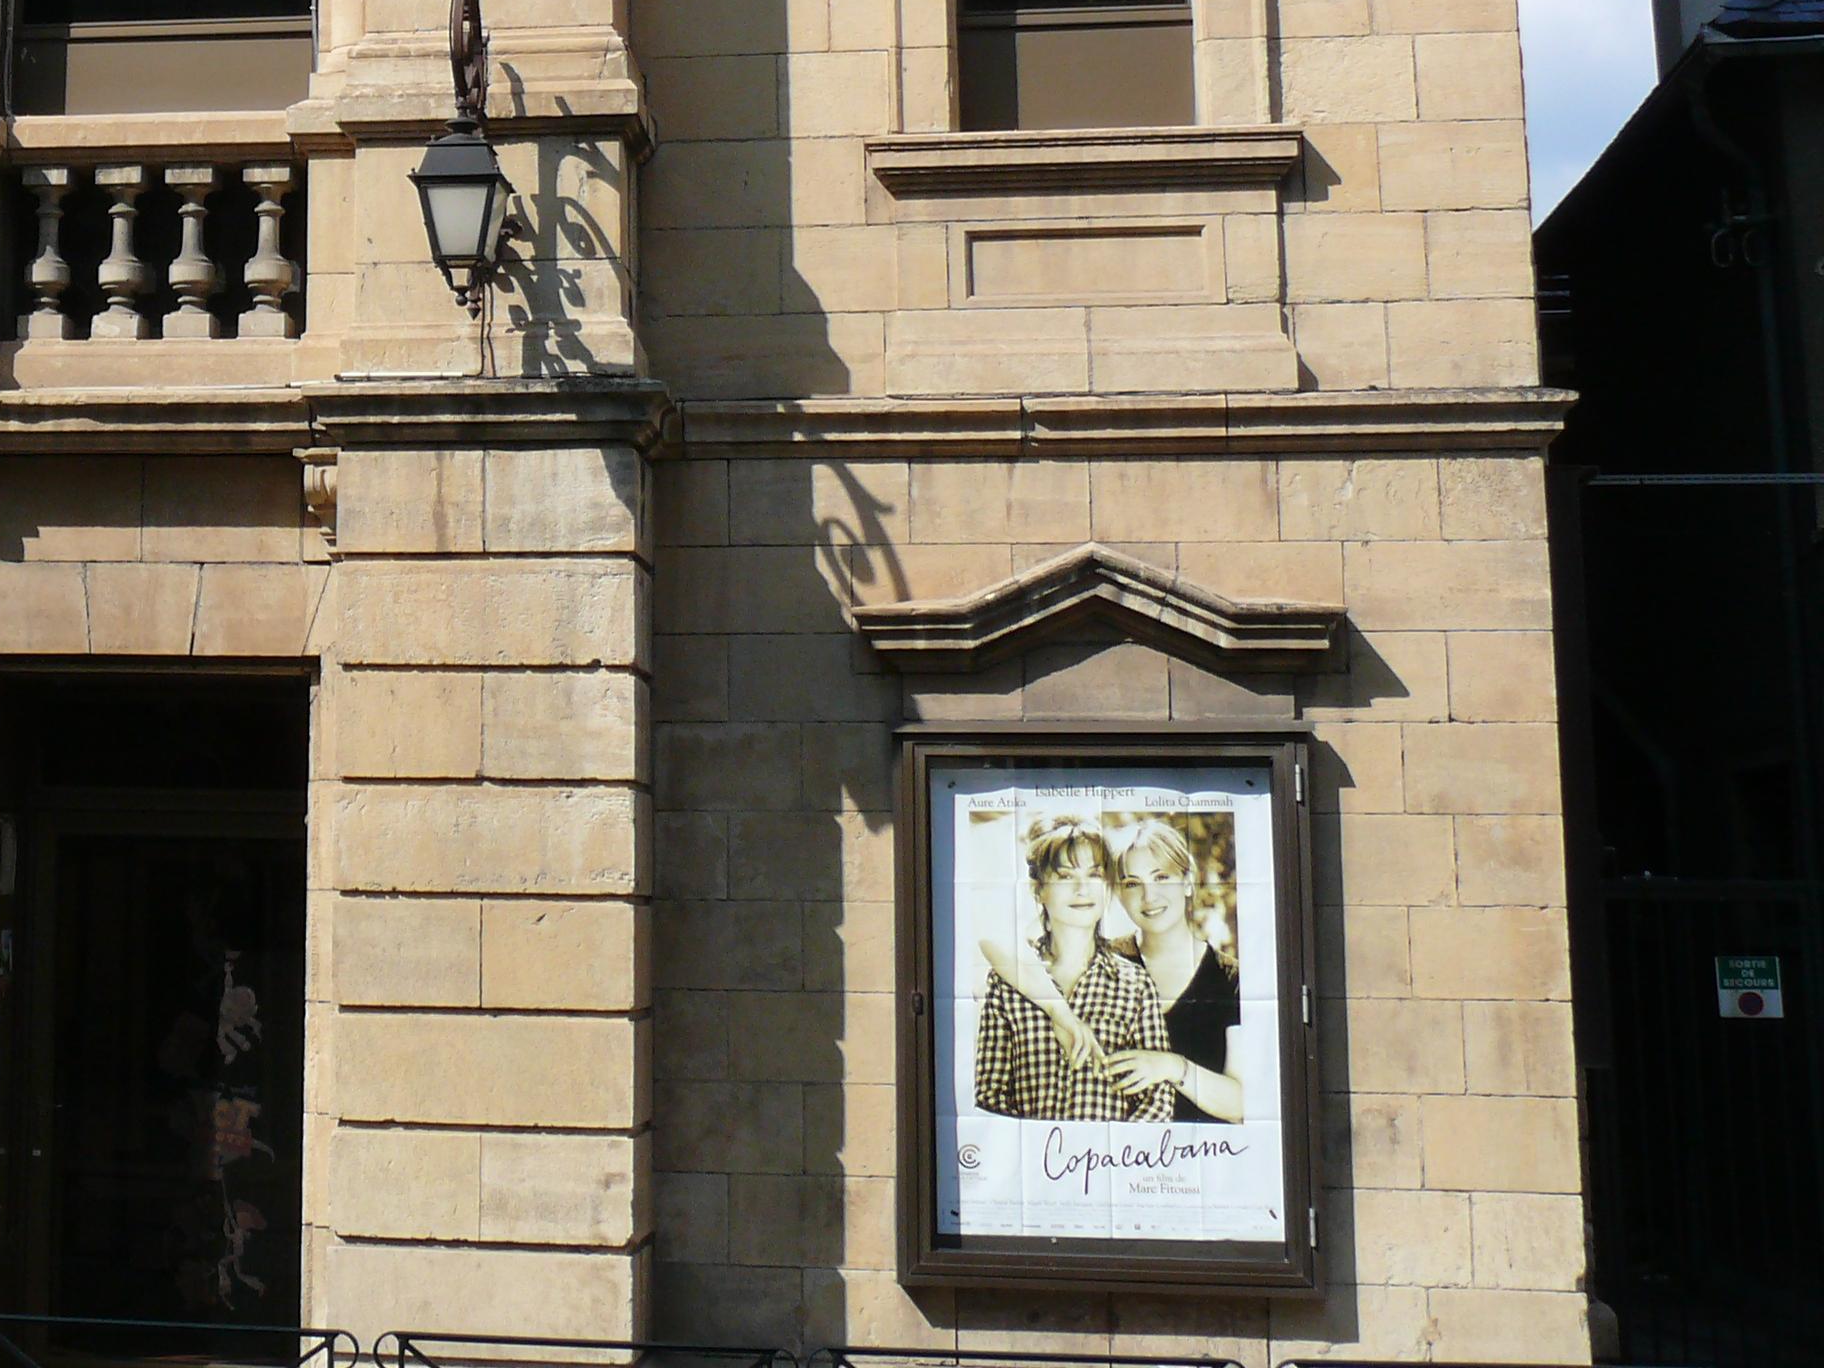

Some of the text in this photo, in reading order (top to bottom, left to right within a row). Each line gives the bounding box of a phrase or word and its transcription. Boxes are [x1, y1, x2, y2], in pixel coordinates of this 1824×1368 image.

[1035, 785, 1136, 801] Isabelle Huppert
[968, 796, 1026, 807] Aure Atika
[1145, 795, 1233, 807] Lolita Chammah
[1728, 959, 1766, 968] SORTIE
[1741, 969, 1755, 978] DE
[1723, 978, 1776, 988] SECOURS
[1044, 1126, 1248, 1195] Copacabana
[1157, 1173, 1174, 1183] film
[1176, 1173, 1186, 1182] de
[1129, 1182, 1201, 1194] Marc Fitoussi
